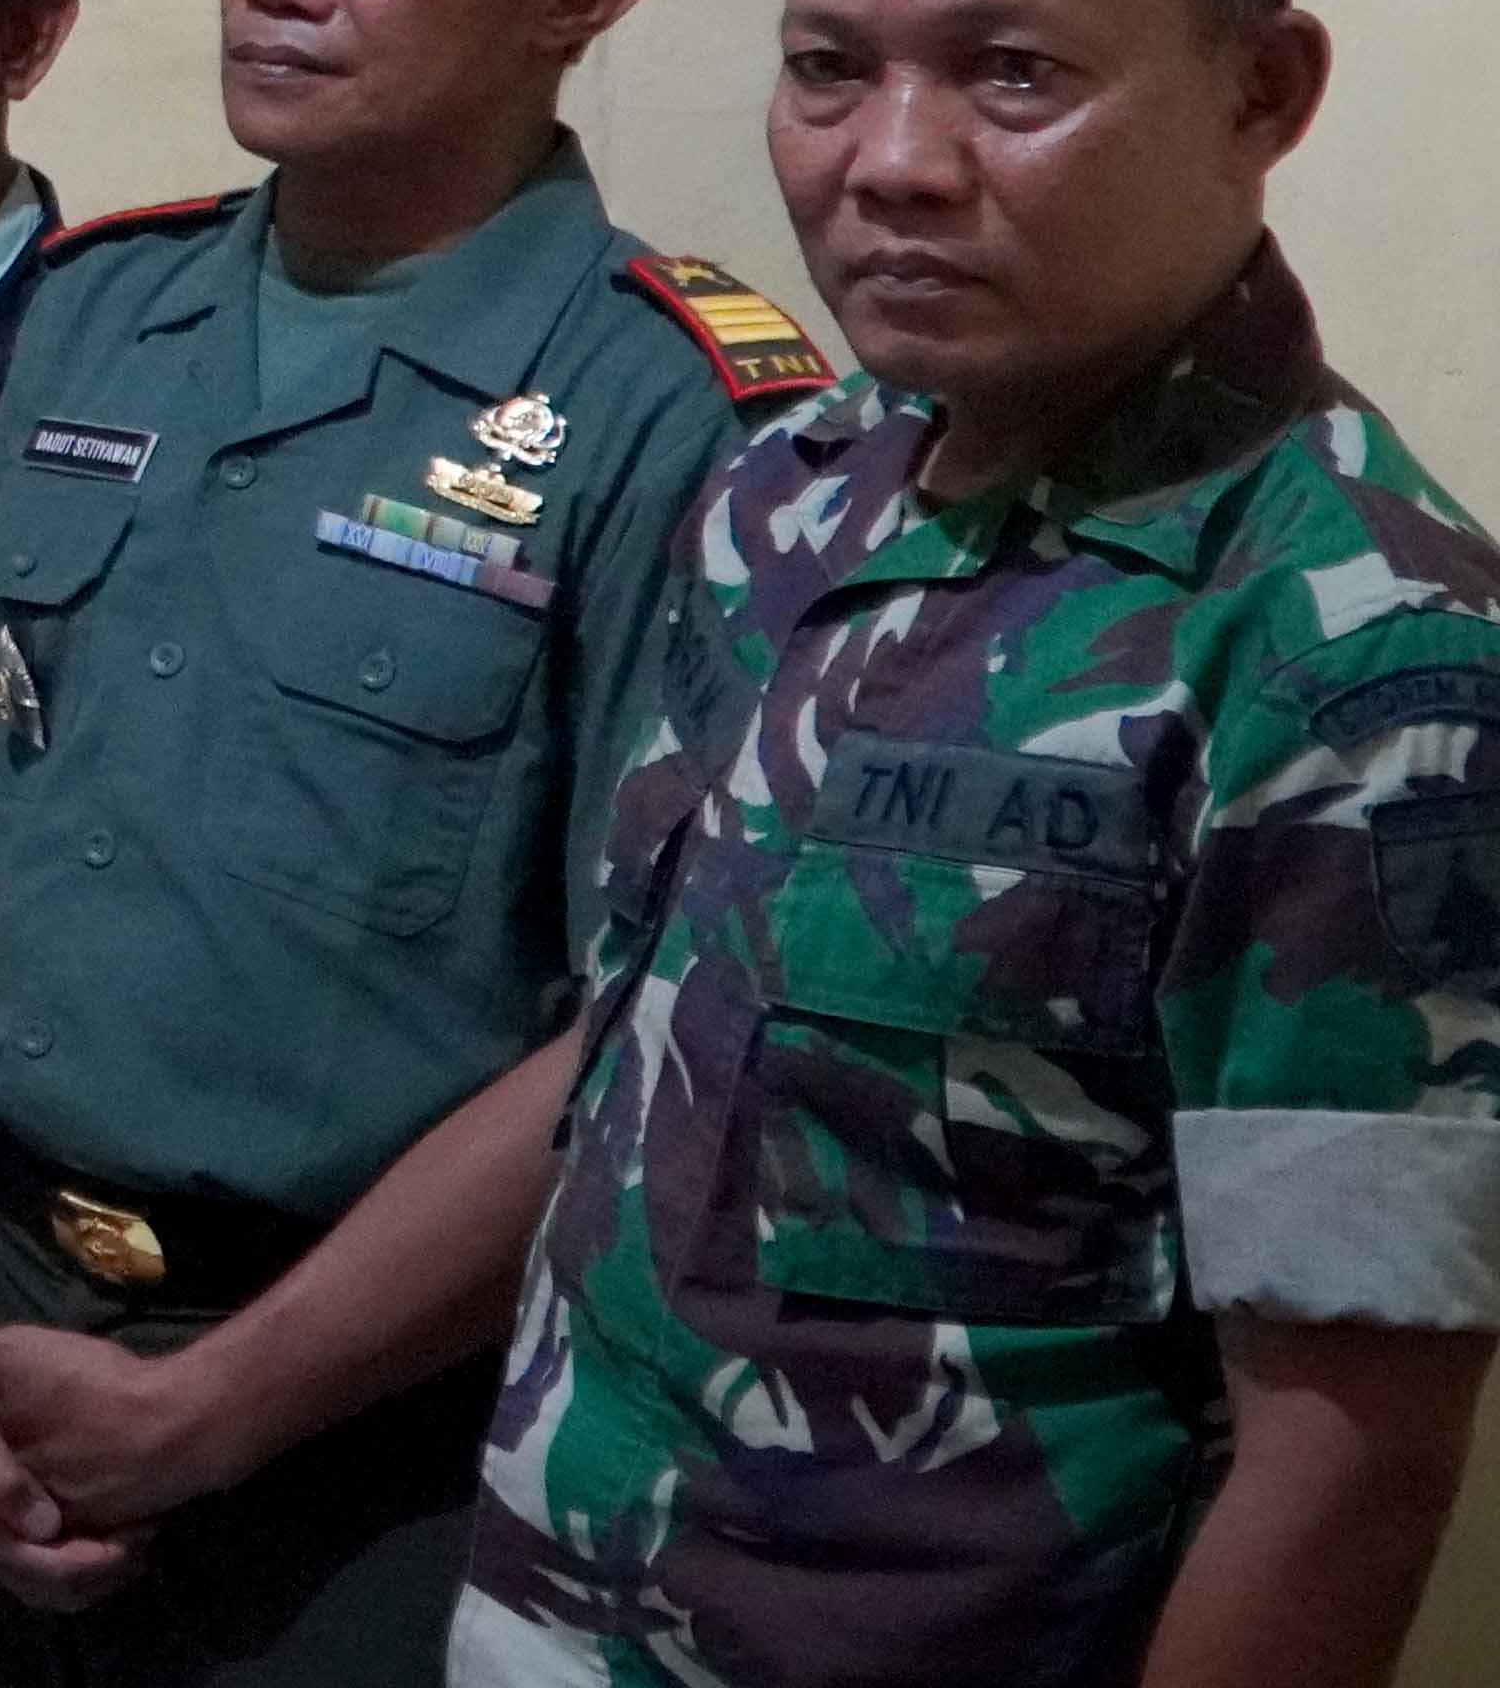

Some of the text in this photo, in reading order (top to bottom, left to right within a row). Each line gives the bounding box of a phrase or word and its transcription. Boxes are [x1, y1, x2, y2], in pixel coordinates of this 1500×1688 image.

[734, 354, 821, 379] TNI
[854, 762, 1099, 850] TNI AD
